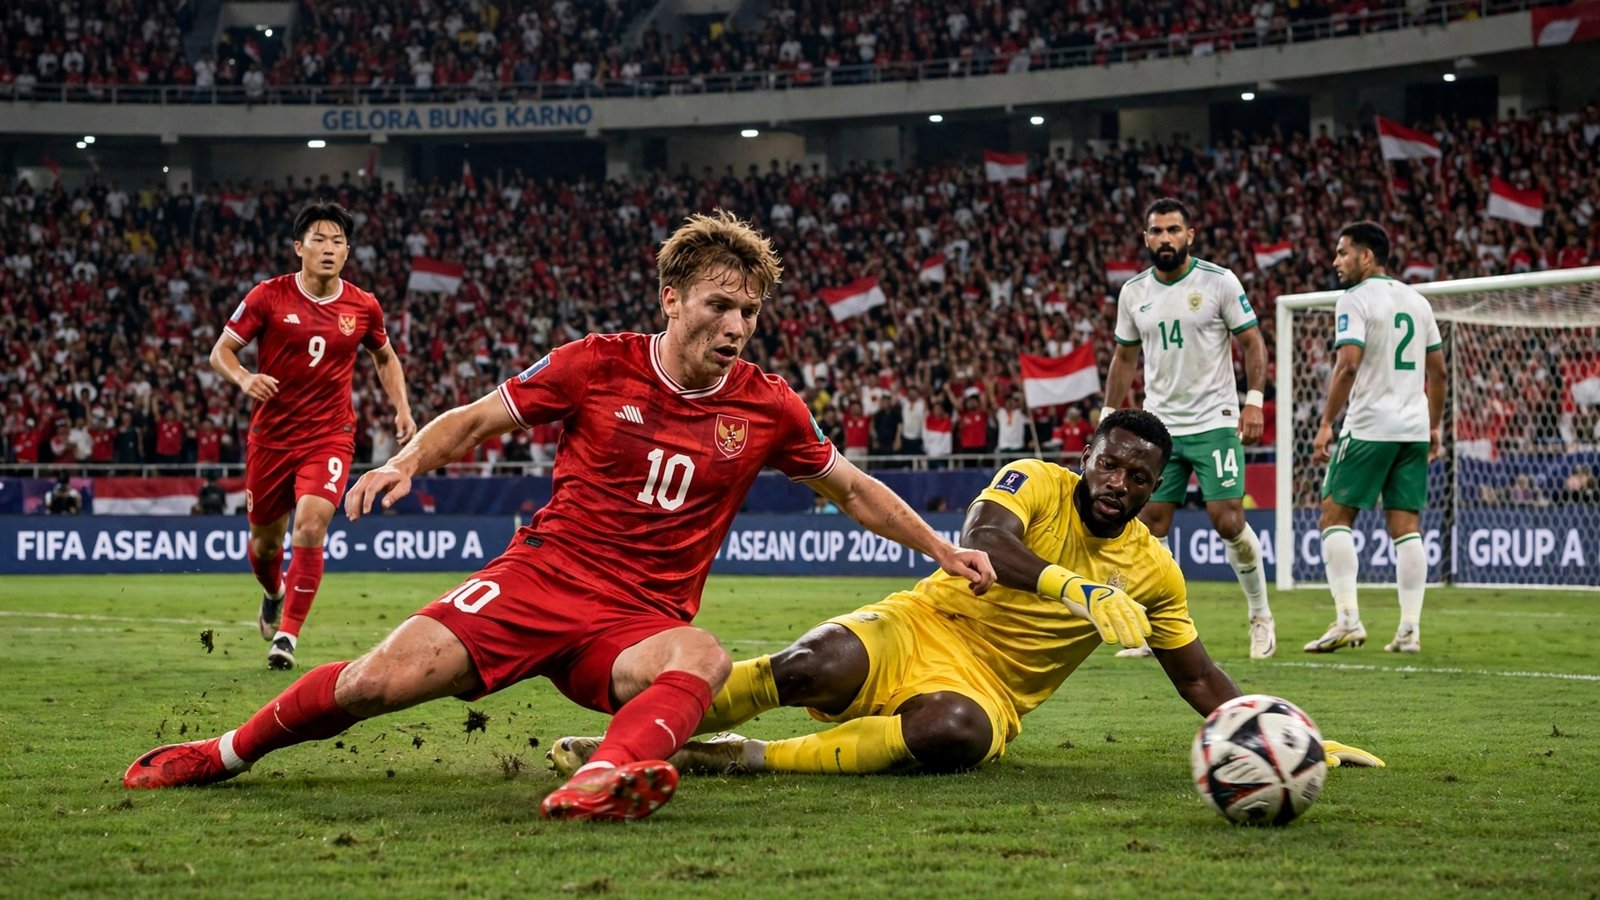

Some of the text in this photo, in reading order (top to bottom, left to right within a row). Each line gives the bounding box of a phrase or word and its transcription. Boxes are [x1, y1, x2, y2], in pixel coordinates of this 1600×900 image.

[322, 104, 593, 131] GELORA BUNG KARNO
[1158, 319, 1184, 350] 14
[1394, 312, 1415, 370] 2
[308, 335, 326, 367] 9
[327, 456, 342, 483] 9
[1212, 448, 1239, 478] 14
[637, 448, 695, 511] 10
[17, 530, 86, 560] FIFA
[91, 530, 197, 560] ASEAN
[205, 530, 252, 560] CU
[373, 530, 456, 560] GRUP
[461, 530, 484, 559] A
[726, 530, 796, 561] ASEAN
[799, 530, 844, 562] CUP
[848, 530, 902, 562] 2026
[1301, 529, 1367, 566] CP
[1469, 528, 1555, 567] GRUP
[1560, 527, 1586, 567] A
[439, 578, 501, 613] 10
